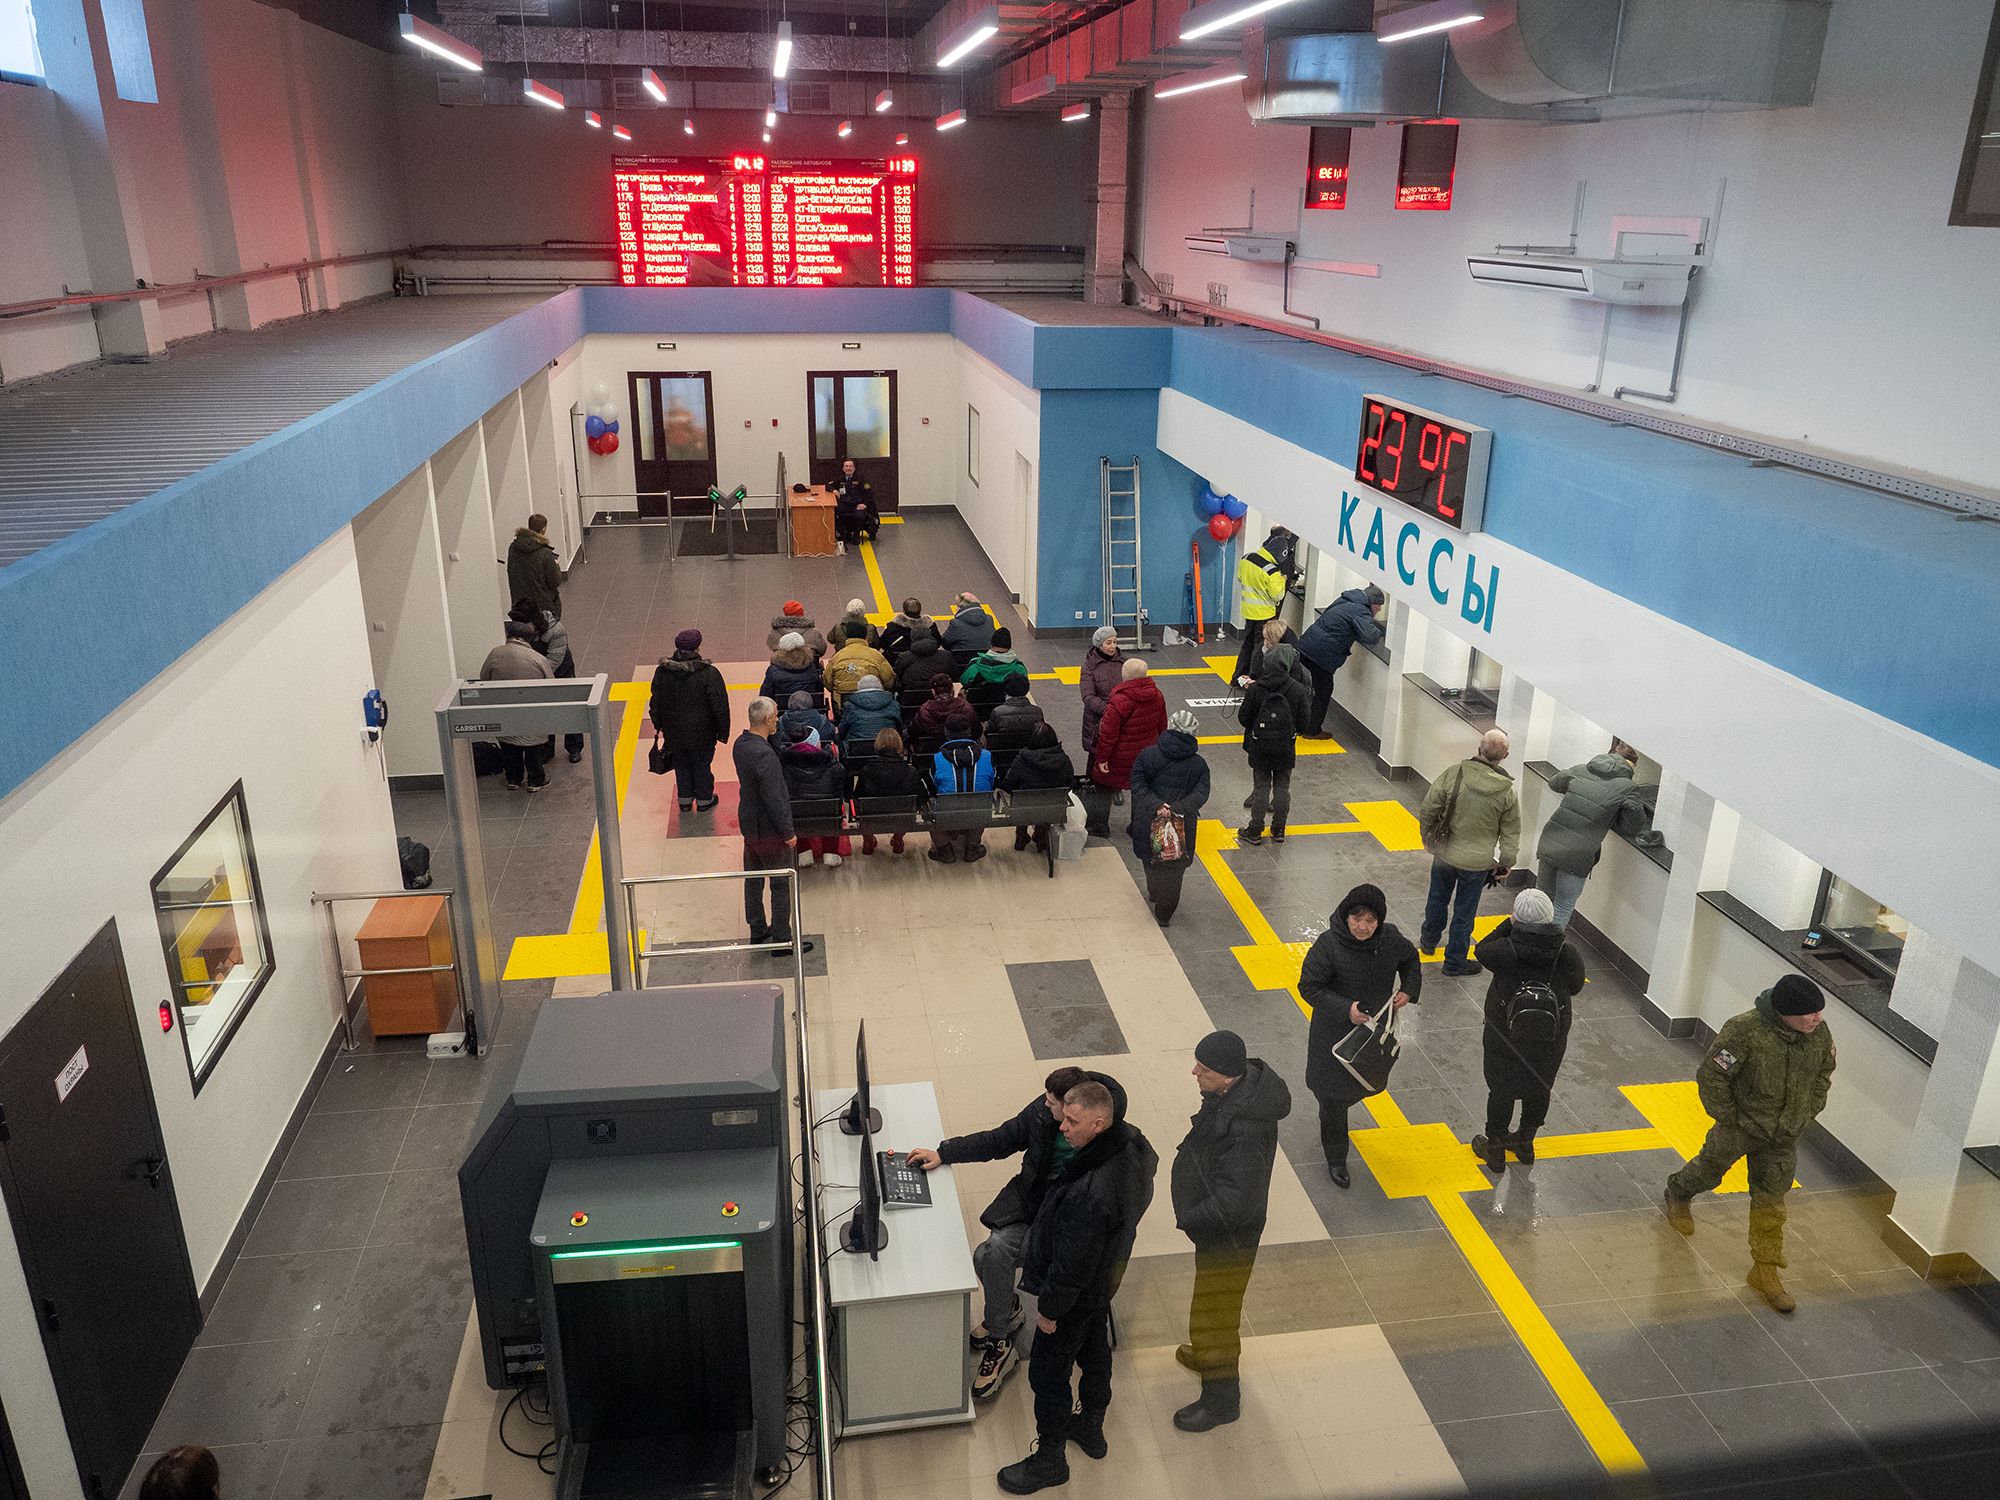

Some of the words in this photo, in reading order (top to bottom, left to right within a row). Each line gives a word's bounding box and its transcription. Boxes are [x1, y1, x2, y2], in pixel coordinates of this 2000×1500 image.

[640, 183, 663, 191] Пряжа
[881, 186, 884, 194] 1
[730, 194, 734, 202] 4
[881, 196, 885, 204] 3
[618, 203, 629, 211] 121
[618, 213, 630, 221] 101
[881, 215, 886, 223] 2
[683, 233, 704, 241] Вилга
[731, 233, 736, 241] 5
[796, 244, 830, 252] Калевала
[644, 254, 682, 263] Кондопога
[796, 255, 834, 263] Беломорск
[882, 255, 886, 263] 2
[733, 265, 738, 273] 4
[797, 276, 823, 284] Олонец
[883, 276, 886, 284] 1
[1360, 402, 1406, 491] 23
[1337, 491, 1500, 634] КАССЫ
[65, 1059, 78, 1079] ПОСТ
[64, 1064, 84, 1092] ОХРАНЫ
